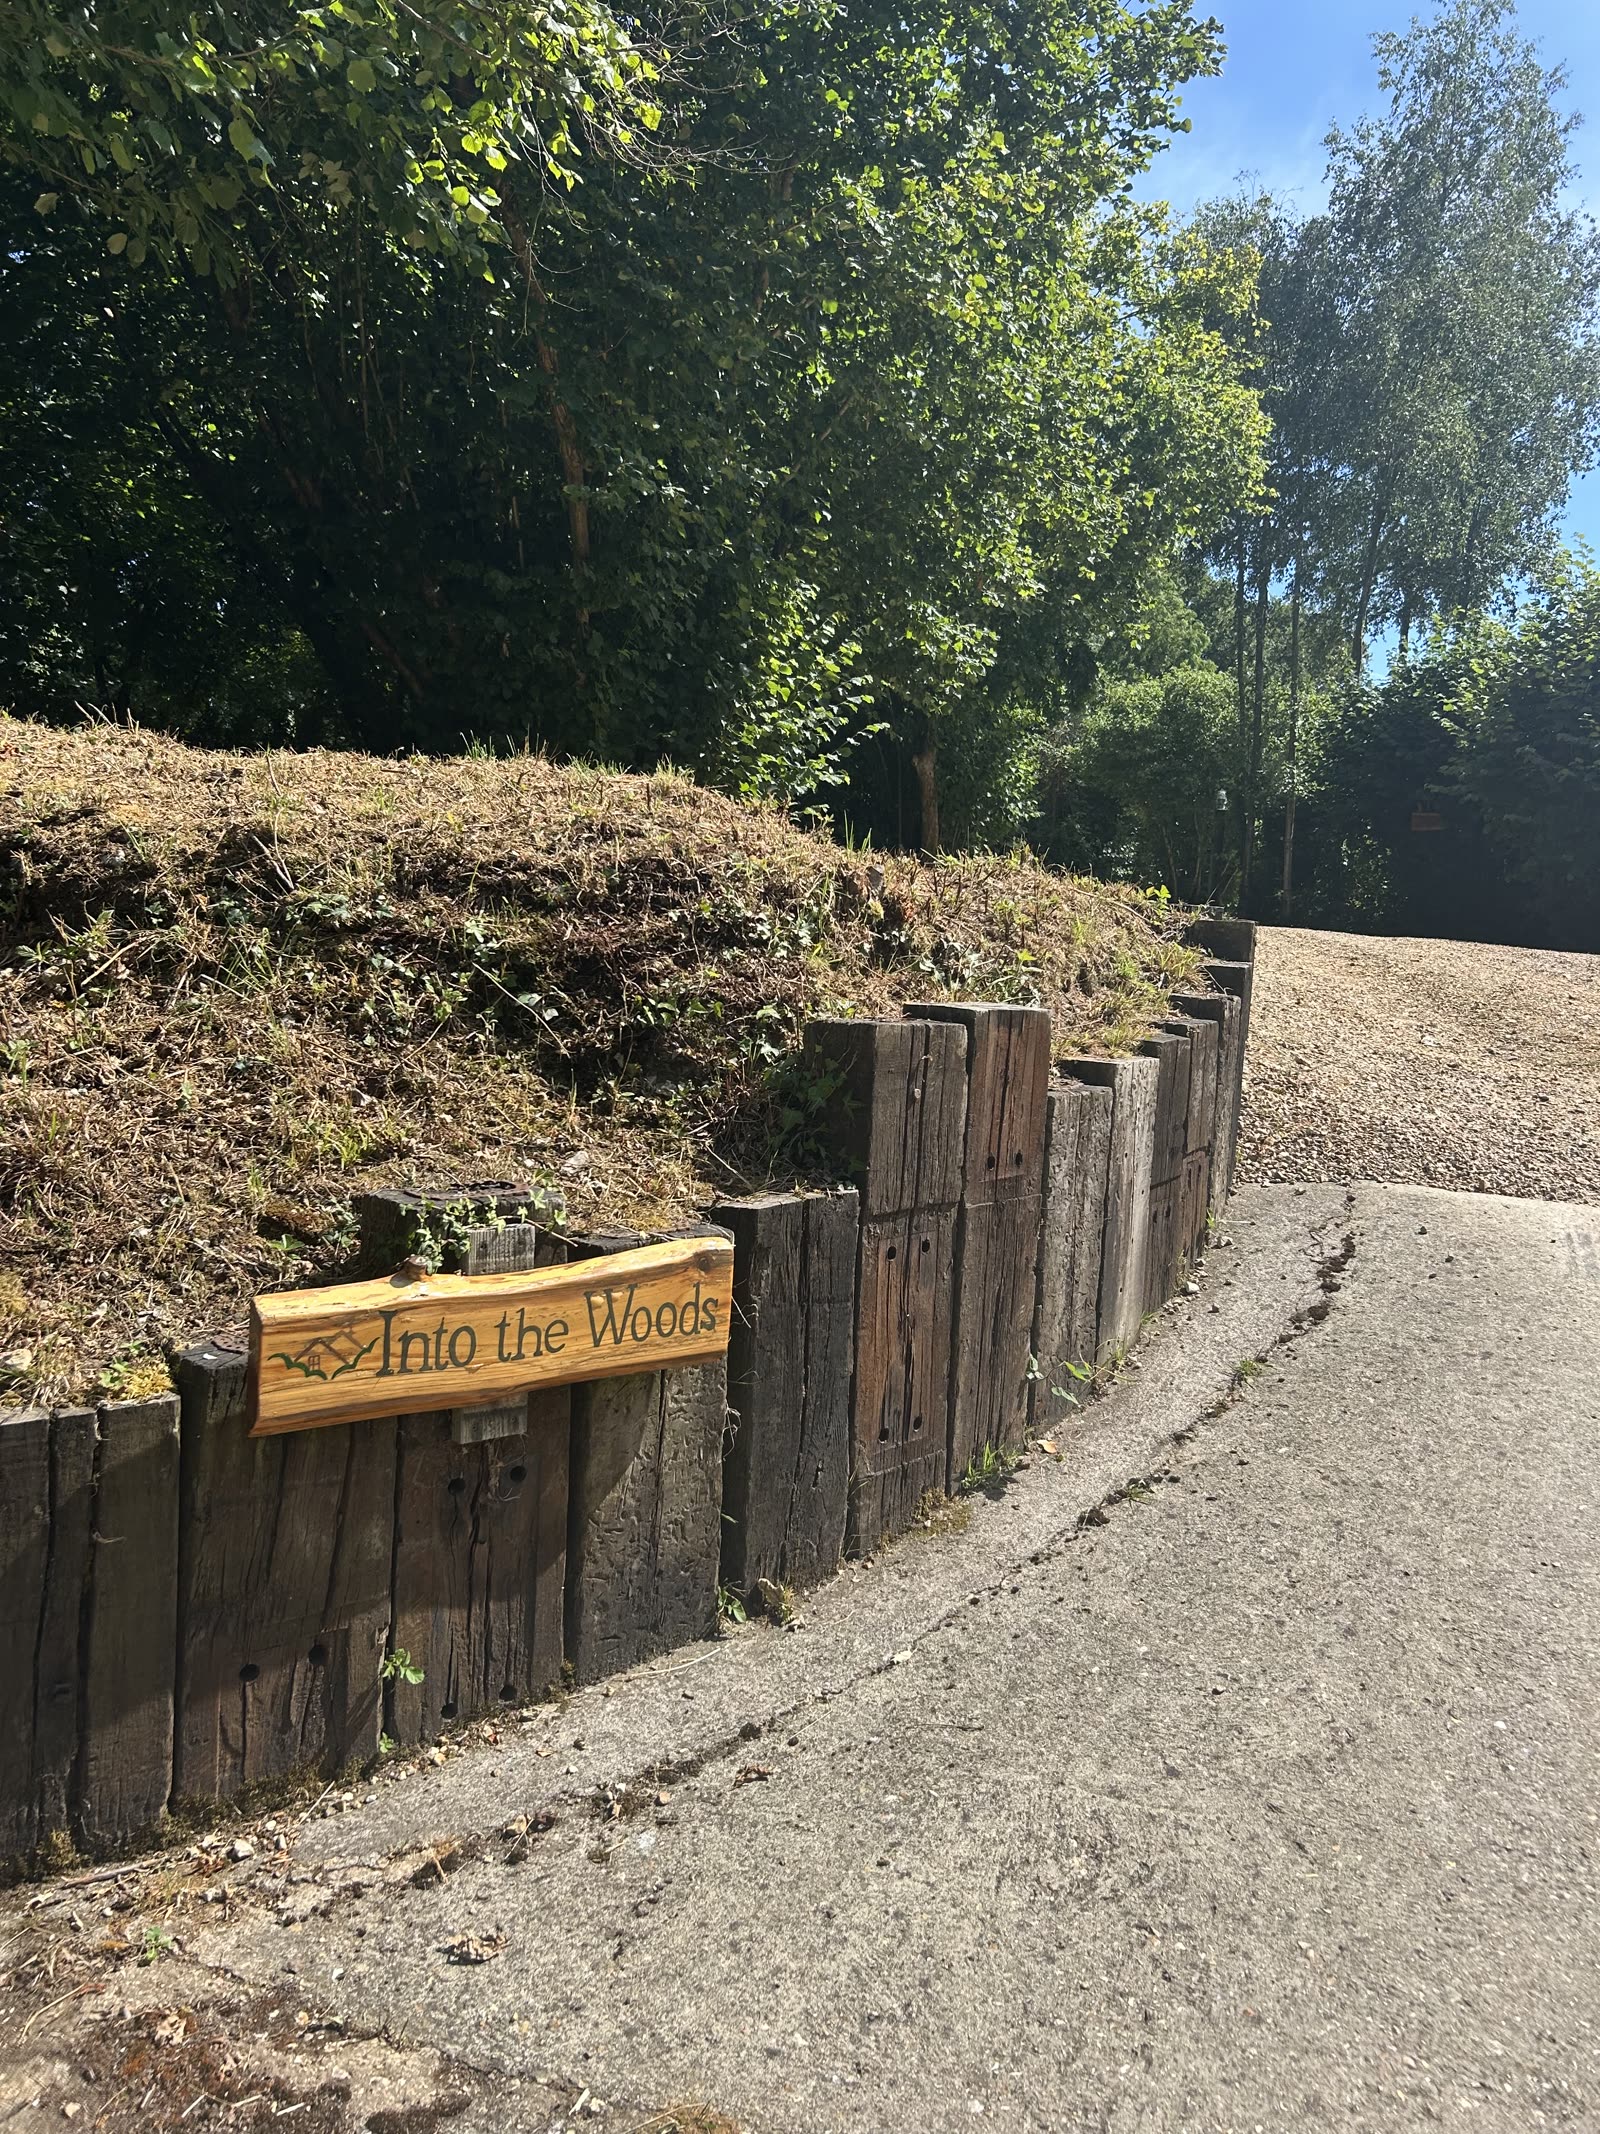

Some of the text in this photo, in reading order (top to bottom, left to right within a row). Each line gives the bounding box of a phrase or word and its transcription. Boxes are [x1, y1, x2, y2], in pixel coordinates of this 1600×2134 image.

[375, 1282, 719, 1377] Into the Woods
